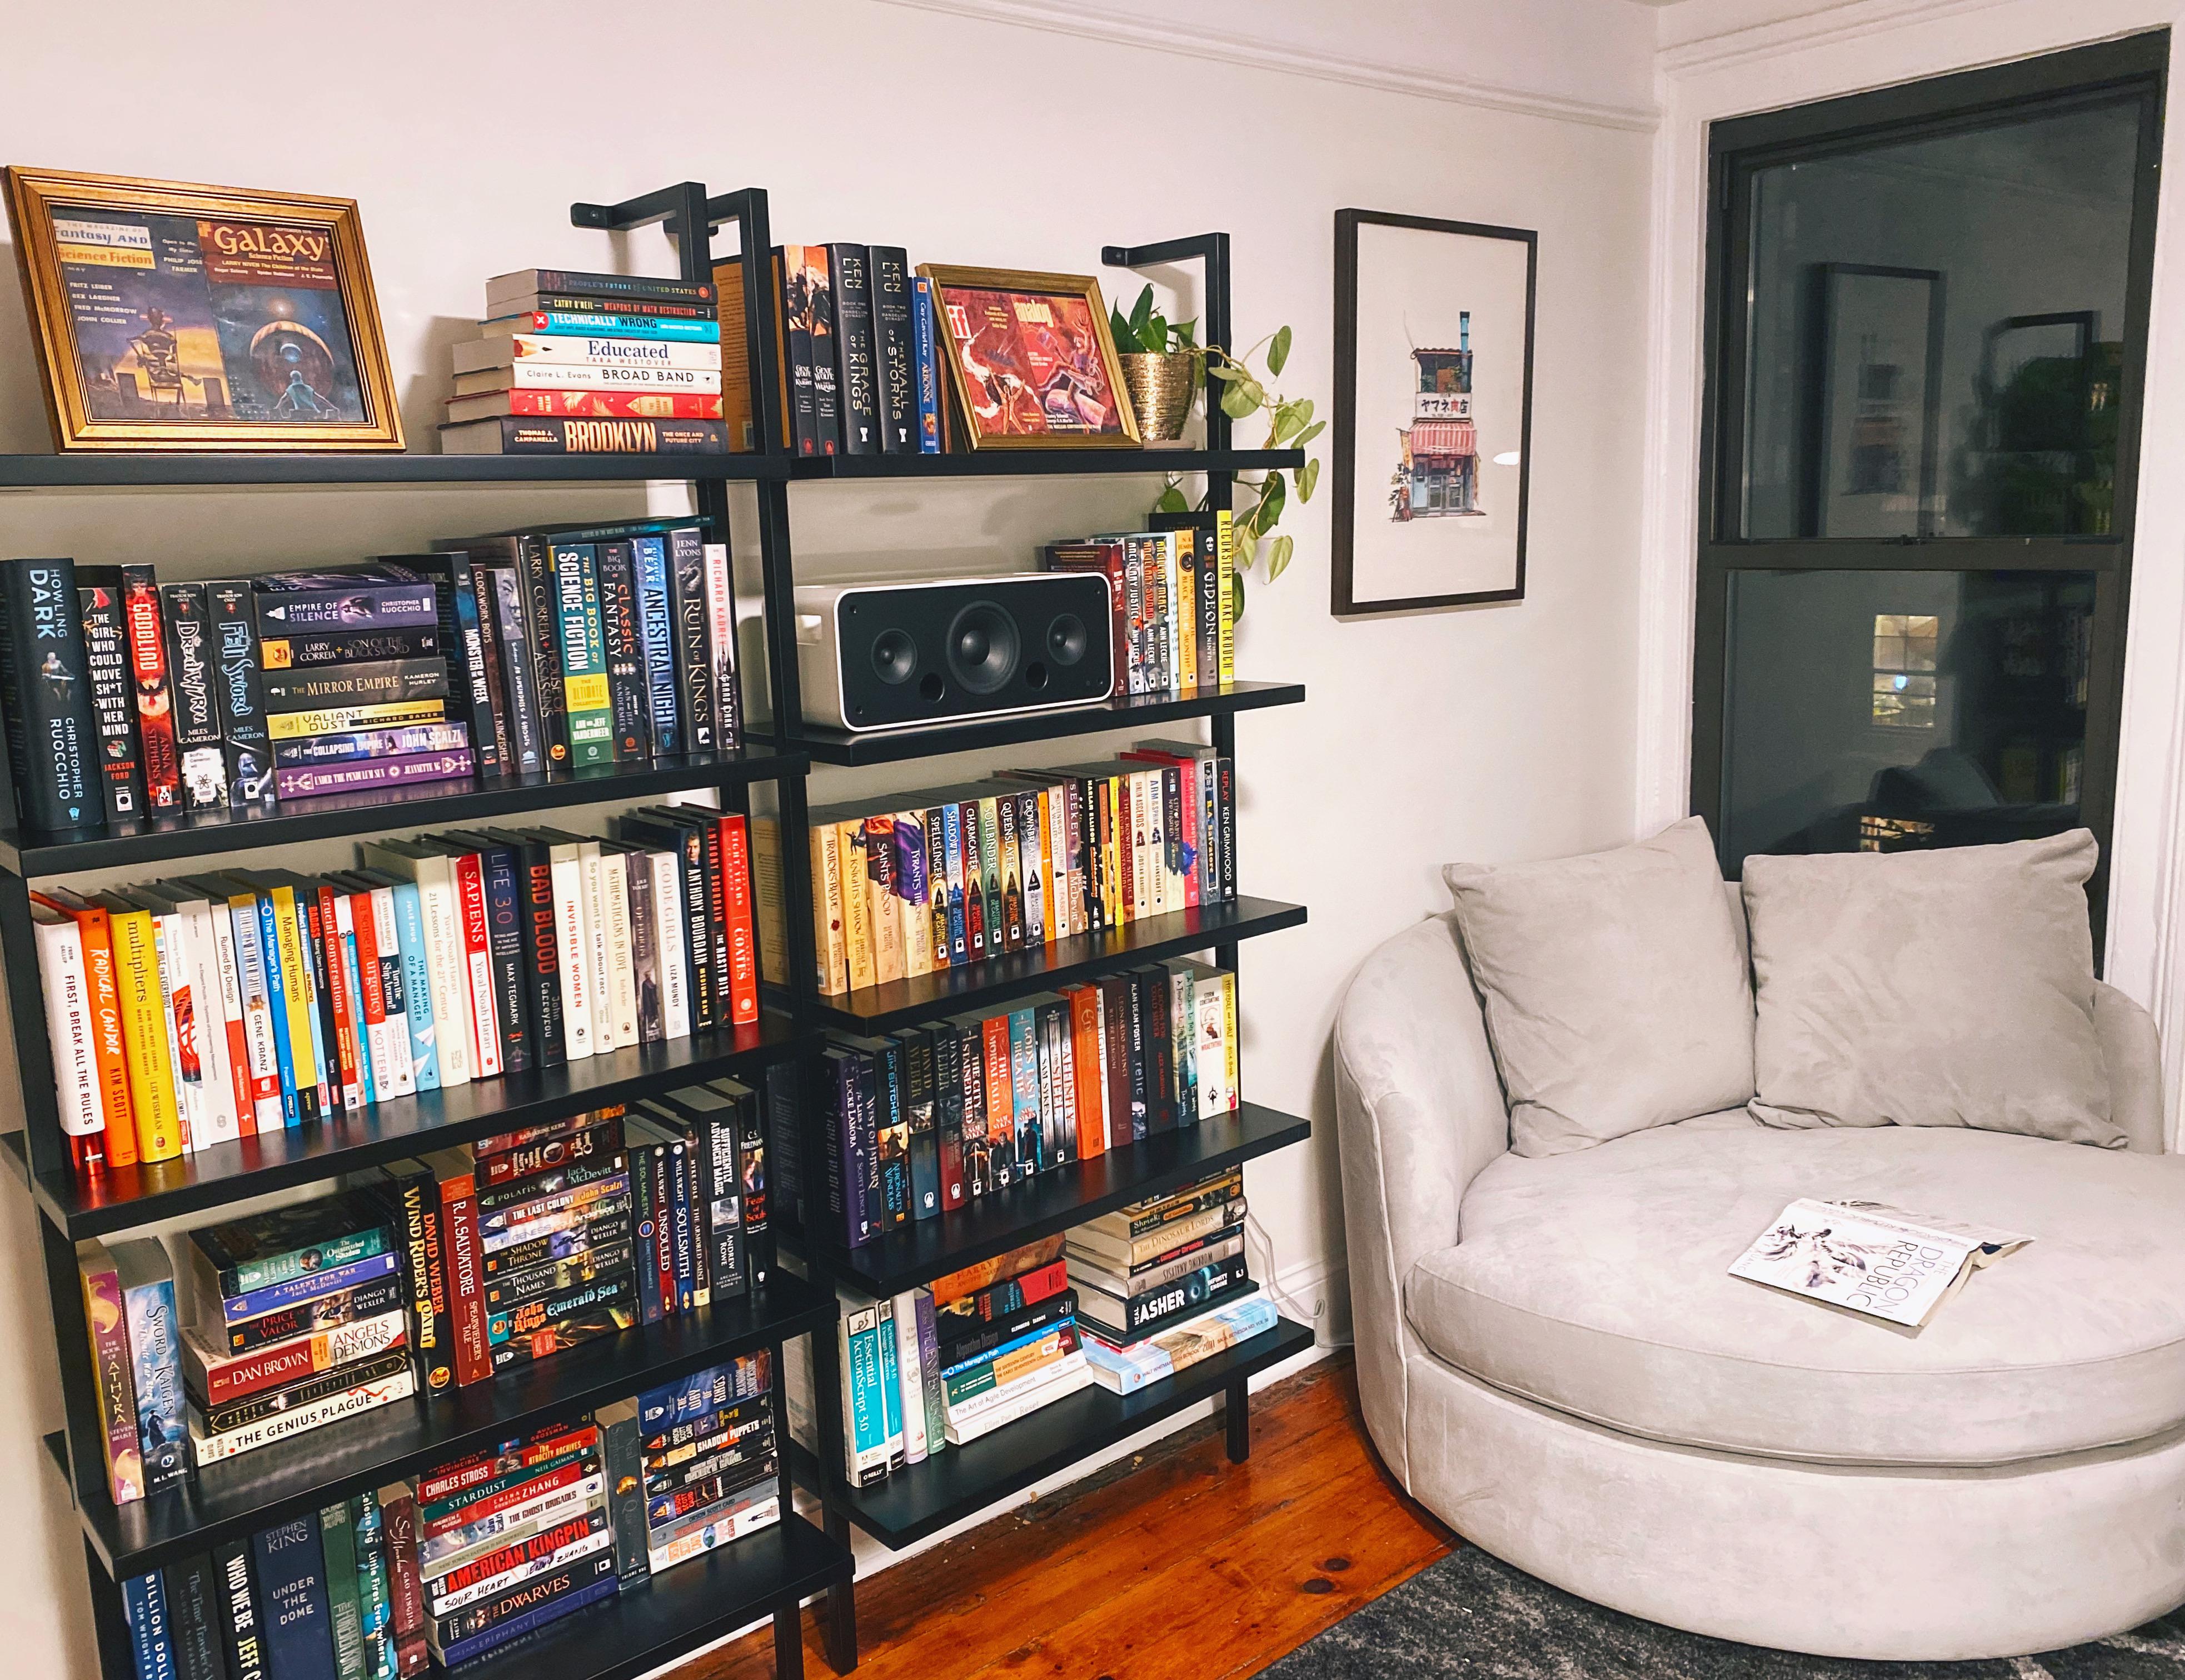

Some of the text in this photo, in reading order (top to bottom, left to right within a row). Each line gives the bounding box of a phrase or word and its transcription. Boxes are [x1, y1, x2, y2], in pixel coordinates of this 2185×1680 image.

[118, 235, 147, 244] AND
[109, 252, 152, 264] Fiction
[842, 258, 854, 288] LIU
[852, 258, 863, 289] KEN
[882, 262, 892, 292] LIU
[892, 263, 901, 292] KEN
[555, 299, 593, 309] CATHY O'NEIL
[552, 313, 616, 326] TECHNICALLY
[618, 317, 656, 328] WRONG
[949, 307, 969, 337] if
[588, 341, 669, 358] Educated
[619, 358, 671, 366] WESTOVER
[603, 369, 650, 381] BROAD
[658, 372, 694, 382] BAND
[850, 335, 862, 410] OF KINGS
[860, 353, 872, 416] GRACE
[888, 330, 901, 420] OF STORMS
[899, 361, 908, 409] WALL
[1421, 399, 1468, 413] ヤマネ肉店
[563, 421, 657, 452] BROOKLYN
[676, 539, 698, 548] JENN
[676, 548, 701, 557] LYONS
[30, 569, 56, 639] DARK
[49, 569, 67, 638] HOWLING
[583, 577, 593, 602] BIG
[1221, 521, 1233, 669] RECURSION BLAKE CROUCH
[93, 614, 109, 623] THE
[290, 602, 337, 612] EMPIRE OF
[290, 611, 339, 622] SILENCE
[382, 604, 421, 613] RUOCCHIO
[558, 553, 588, 671] SCIENCE FICTION
[93, 627, 116, 639] GIRL
[587, 606, 598, 647] BOOK
[90, 654, 122, 666] COULD
[92, 641, 115, 652] WHO
[300, 651, 336, 662] CORREIA
[306, 643, 330, 652] LARRY
[645, 588, 675, 726] ANCESTRAL NIGHT
[93, 669, 121, 681] MOVE
[307, 679, 353, 696] MIRROR
[356, 676, 398, 692] EMPIRE
[98, 697, 124, 708] WITH
[104, 712, 124, 722] HER
[303, 709, 363, 723] VALIANT
[103, 724, 129, 736] MIND
[310, 721, 345, 731] DUST
[363, 716, 403, 724] RICHARD
[181, 734, 220, 744] CAMERON
[402, 729, 461, 748] JOHN SCALZI
[50, 718, 70, 800] RUOCCHIO
[66, 717, 83, 798] CHRISTOPHER
[931, 817, 942, 883] SPELLSLINGER
[947, 811, 960, 880] SHADOWBLACK
[966, 808, 977, 875] CHARMCASTER
[984, 807, 997, 874] SOULBINDER
[465, 872, 483, 943] SAPIENS
[1069, 877, 1079, 921] McDevitt
[530, 865, 556, 974] BAD BLOOD
[688, 869, 706, 966] ANTHONY BOURDAIN
[127, 921, 151, 1002] multipliers
[221, 937, 231, 963] Ruined
[267, 934, 278, 972] Manager's
[282, 917, 300, 1002] Managing Humans
[567, 900, 582, 1007] INVISIBLE WOMEN
[734, 927, 746, 981] COATES
[223, 964, 231, 974] By
[506, 963, 518, 1024] MAX TEGMARK
[90, 948, 127, 1118] RADICAL CANDOR KIM SCOTT
[65, 975, 93, 1125] FIRST, BREAK ALL THE RULES
[1134, 1062, 1144, 1095] relic
[888, 1072, 897, 1124] BUTCHER
[657, 1208, 670, 1272] UNSOULED
[676, 1207, 690, 1279] SOULSMITH
[726, 1235, 735, 1269] ANDREW
[1847, 1241, 1918, 1307] REPUBLIC
[1874, 1247, 1943, 1313] DRAGON
[1941, 1259, 1955, 1276] THE
[354, 1288, 386, 1303] DJANGO
[356, 1297, 385, 1310] WEXLER
[1140, 1289, 1185, 1323] ASHER
[333, 1319, 390, 1347] ANGELS
[334, 1333, 391, 1359] DEMONS
[233, 1351, 308, 1386] DAN BROWN
[864, 1334, 877, 1388] Essential
[854, 1339, 869, 1432] ActionScript 3.0
[955, 1407, 967, 1417] The
[969, 1402, 978, 1411] Art
[985, 1393, 999, 1404] Agile
[1001, 1376, 1036, 1397] Development
[236, 1394, 372, 1447] THE GENIUS PLAGUE
[426, 1466, 488, 1497] CHARLES STROSS
[448, 1479, 507, 1510] STARDUST
[265, 1520, 307, 1542] STEPHEN
[268, 1529, 308, 1554] KING
[447, 1519, 590, 1593] AMERICAN KINGPIN
[273, 1577, 315, 1600] UNDER
[282, 1593, 307, 1609] THE
[445, 1577, 510, 1608] SOUR HEART
[501, 1573, 570, 1616] DWARVES
[280, 1604, 314, 1626] DOME
